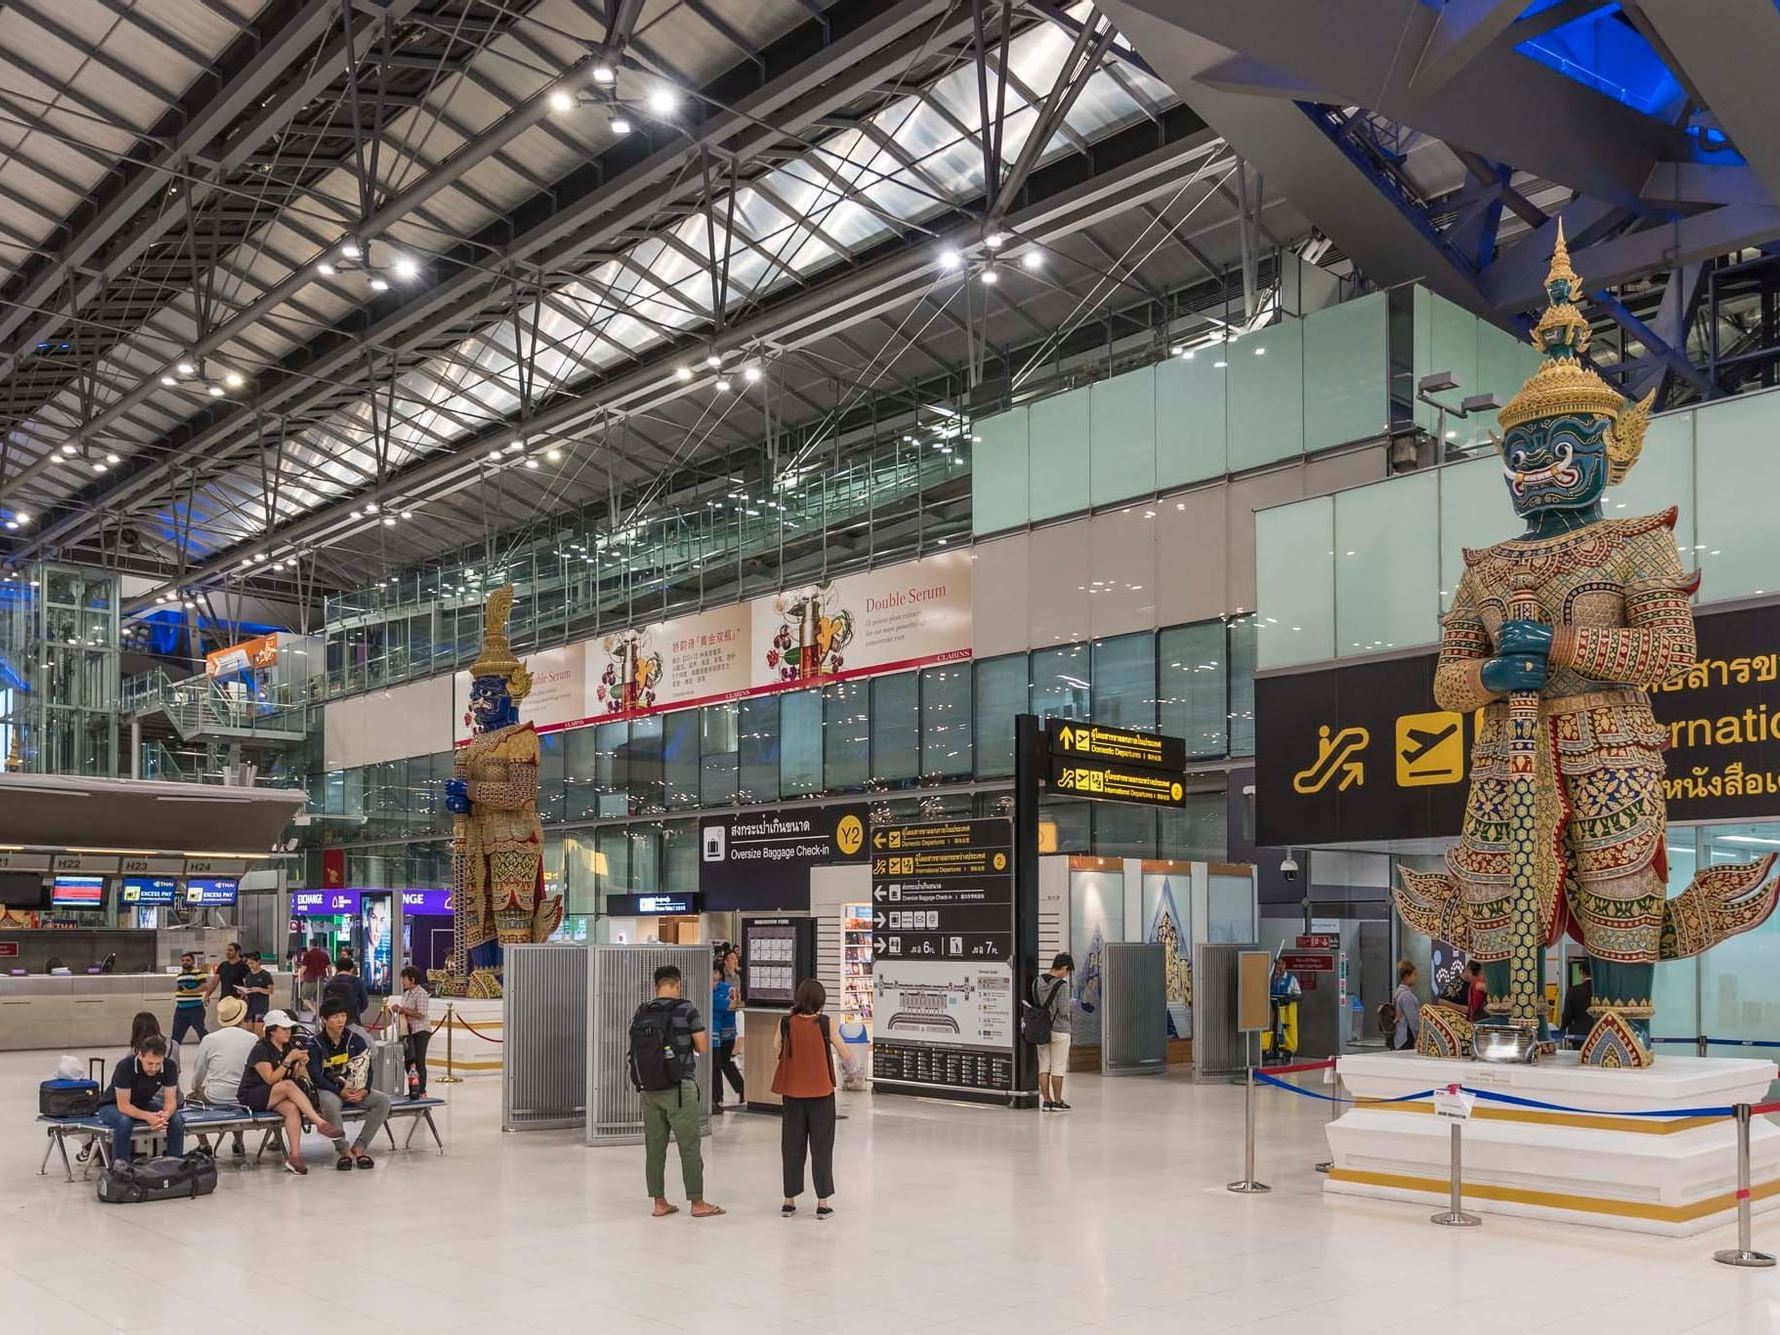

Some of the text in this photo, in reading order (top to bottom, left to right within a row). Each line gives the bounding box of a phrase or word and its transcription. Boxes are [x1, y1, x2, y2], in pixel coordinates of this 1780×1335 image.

[866, 585, 946, 613] Double Serum
[937, 650, 970, 662] CLARINS
[1662, 761, 1780, 800] หนังสือเ
[841, 826, 860, 845] Y2
[731, 843, 830, 860] Oversize Baggage Check-in
[58, 859, 81, 868] H22
[126, 862, 148, 871] H23
[996, 856, 1003, 866] 2
[190, 863, 211, 872] H24
[297, 894, 323, 905] EXCHANGE
